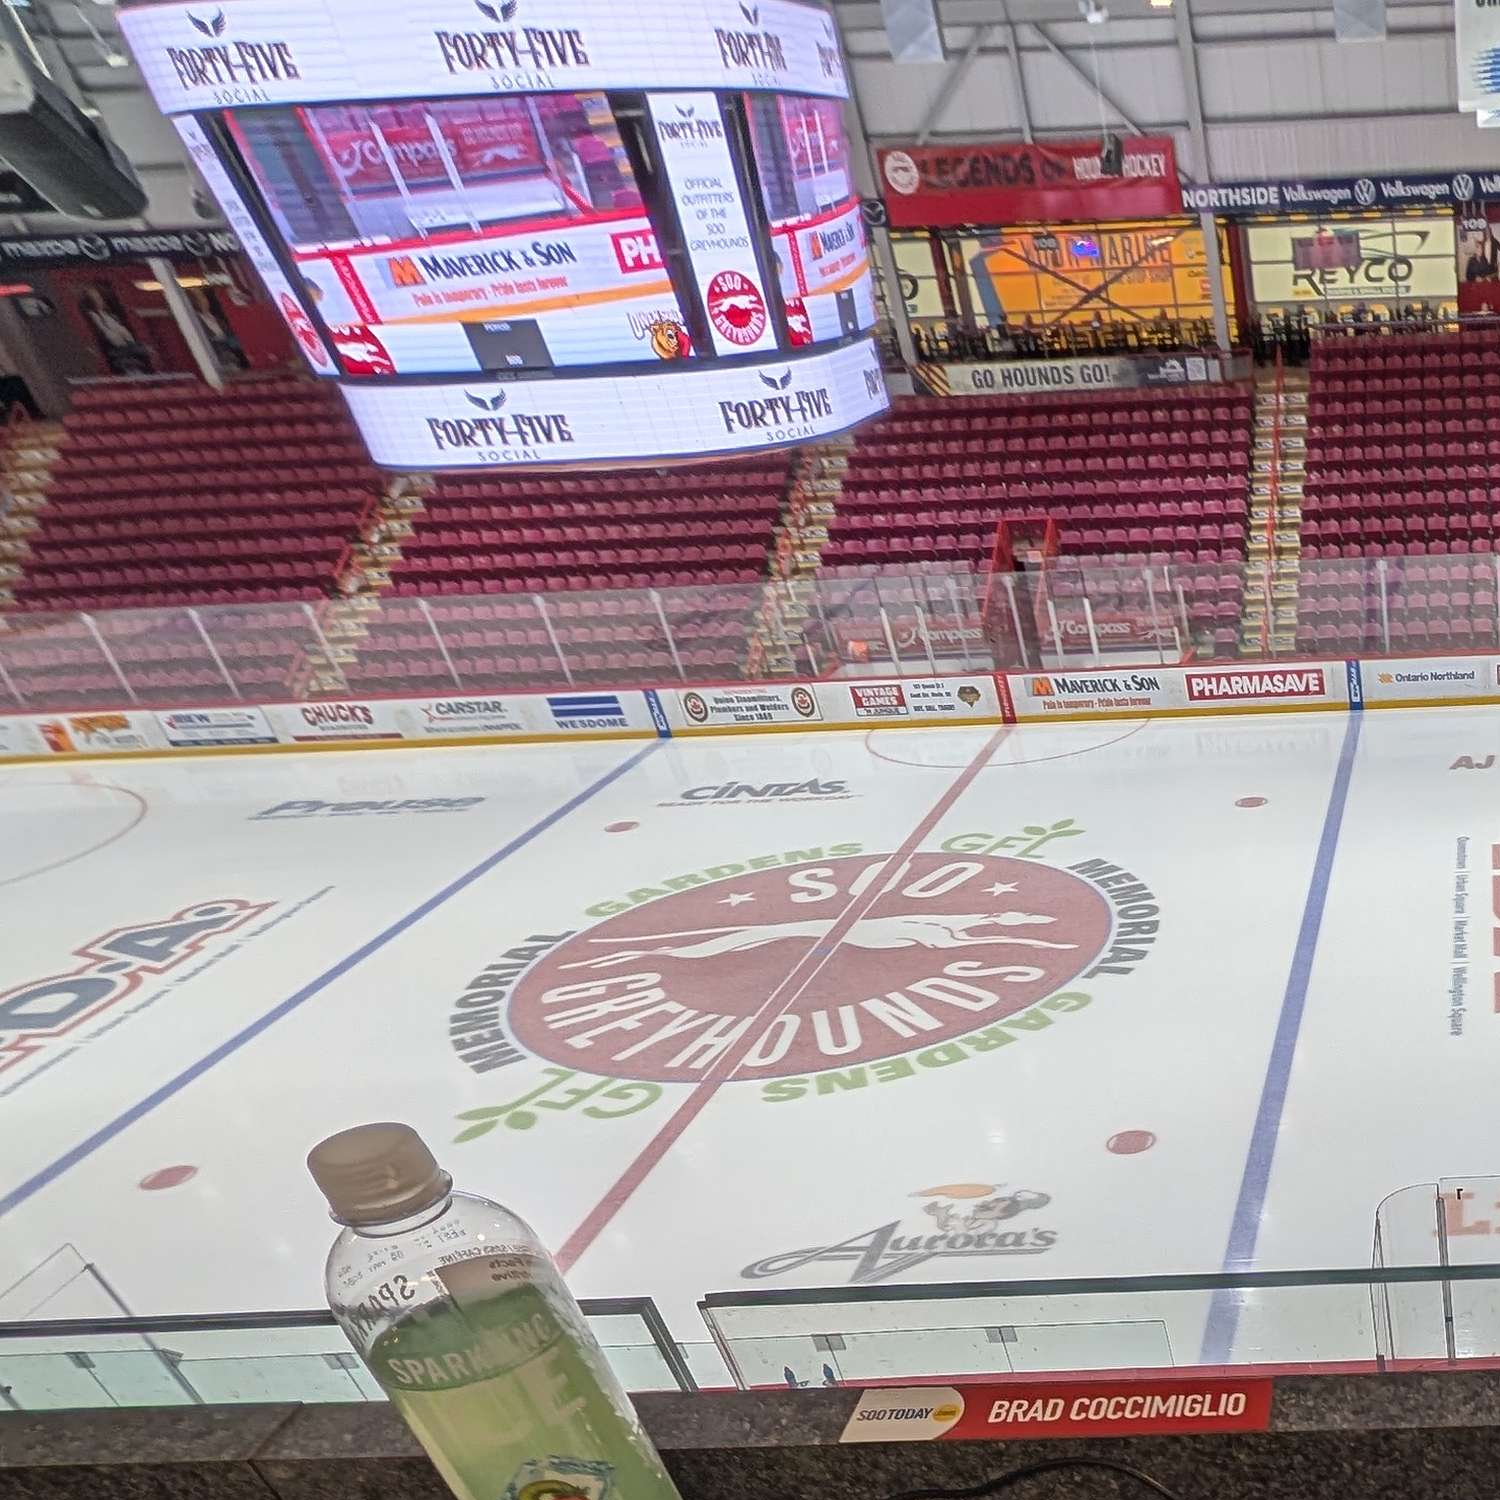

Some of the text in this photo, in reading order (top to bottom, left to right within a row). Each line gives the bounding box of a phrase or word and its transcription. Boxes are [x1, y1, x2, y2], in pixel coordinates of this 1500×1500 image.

[434, 27, 591, 74] FORTY-FIVE
[166, 41, 302, 90] FORTY-FIVE
[492, 74, 555, 89] SOCIAL
[1124, 153, 1167, 178] HOCKEY
[1181, 185, 1280, 209] NORTHSIDE
[1283, 184, 1351, 207] Volkswagen
[418, 246, 515, 281] MAVERICK
[532, 241, 577, 266] SON
[1292, 257, 1413, 297] REYCO
[972, 363, 1111, 389] GO HOUNDS GO!
[718, 388, 833, 434] FORTY-FIVE
[426, 413, 574, 450] FORTY-FIVE
[767, 425, 817, 442] SOCIAL
[478, 449, 541, 463] SOCIAL
[1053, 677, 1120, 694] MAVERICK
[1131, 674, 1160, 692] SON
[1191, 673, 1321, 698] PHARMASAVE
[1395, 670, 1475, 682] Ontario Northland
[854, 687, 898, 698] VINTAGE
[861, 696, 898, 706] GAMES
[300, 704, 374, 726] CHUCK'S
[435, 701, 502, 715] CARSTAR
[556, 717, 628, 729] WESDOME
[1449, 754, 1495, 770] AJ
[940, 826, 1056, 860] GFL
[585, 842, 864, 917] GARDENS
[789, 860, 986, 904] SOO
[1069, 857, 1161, 980] MEMORIAL
[448, 929, 577, 1075] MEMORIAL
[540, 959, 1046, 1070] GREYHOUNDS
[760, 990, 1094, 1103] GARDENS
[740, 1219, 1059, 1285] Aurora's
[855, 1393, 1247, 1425] SOOTODAY BRAD COCCIMIGLIO
